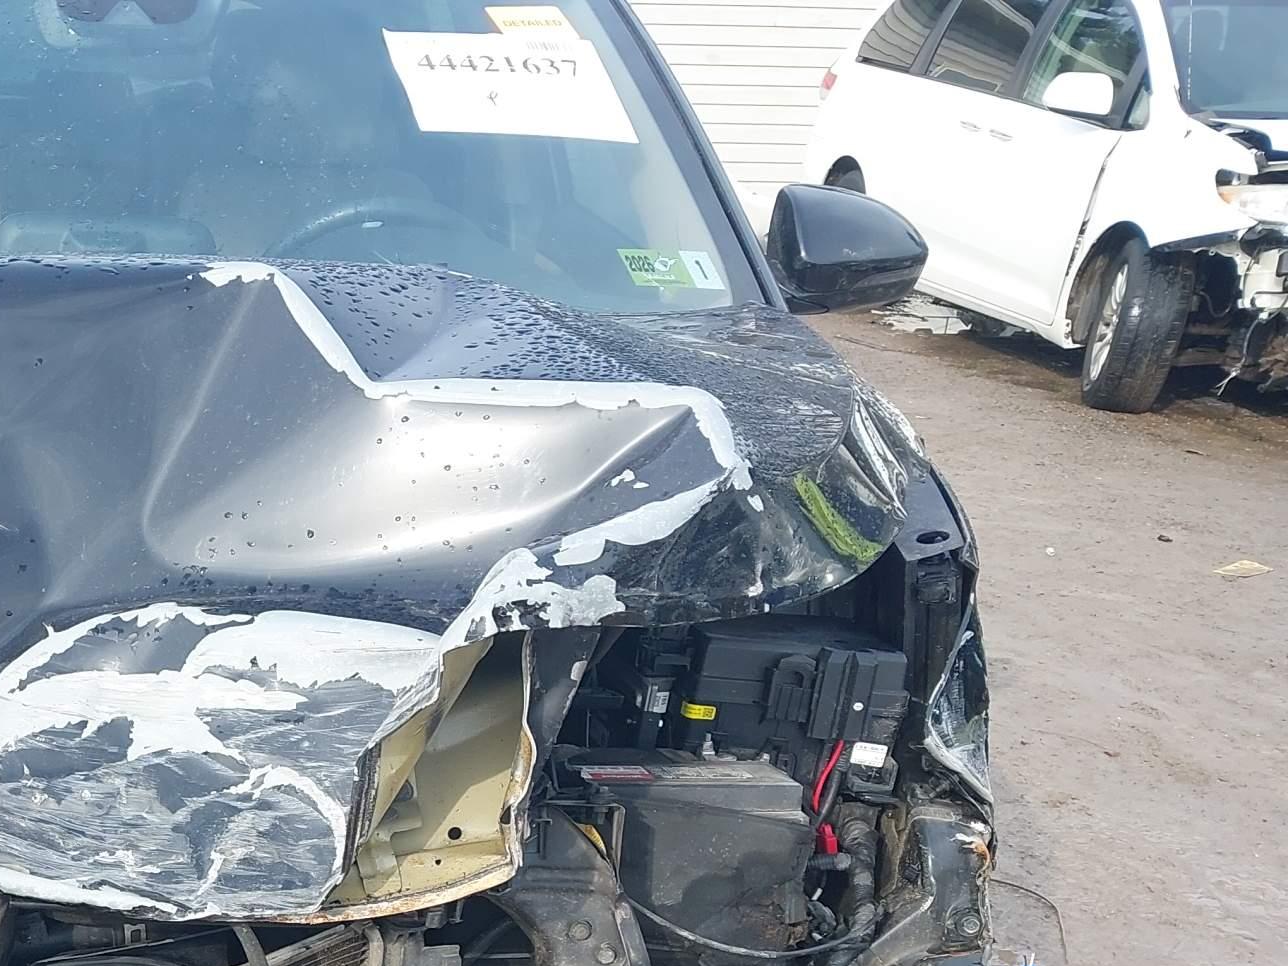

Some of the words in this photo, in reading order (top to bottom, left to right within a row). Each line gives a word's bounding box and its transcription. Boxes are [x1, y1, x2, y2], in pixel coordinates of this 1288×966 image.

[417, 54, 577, 77] 44421637
[624, 255, 656, 273] 2026
[695, 260, 709, 281] 1
